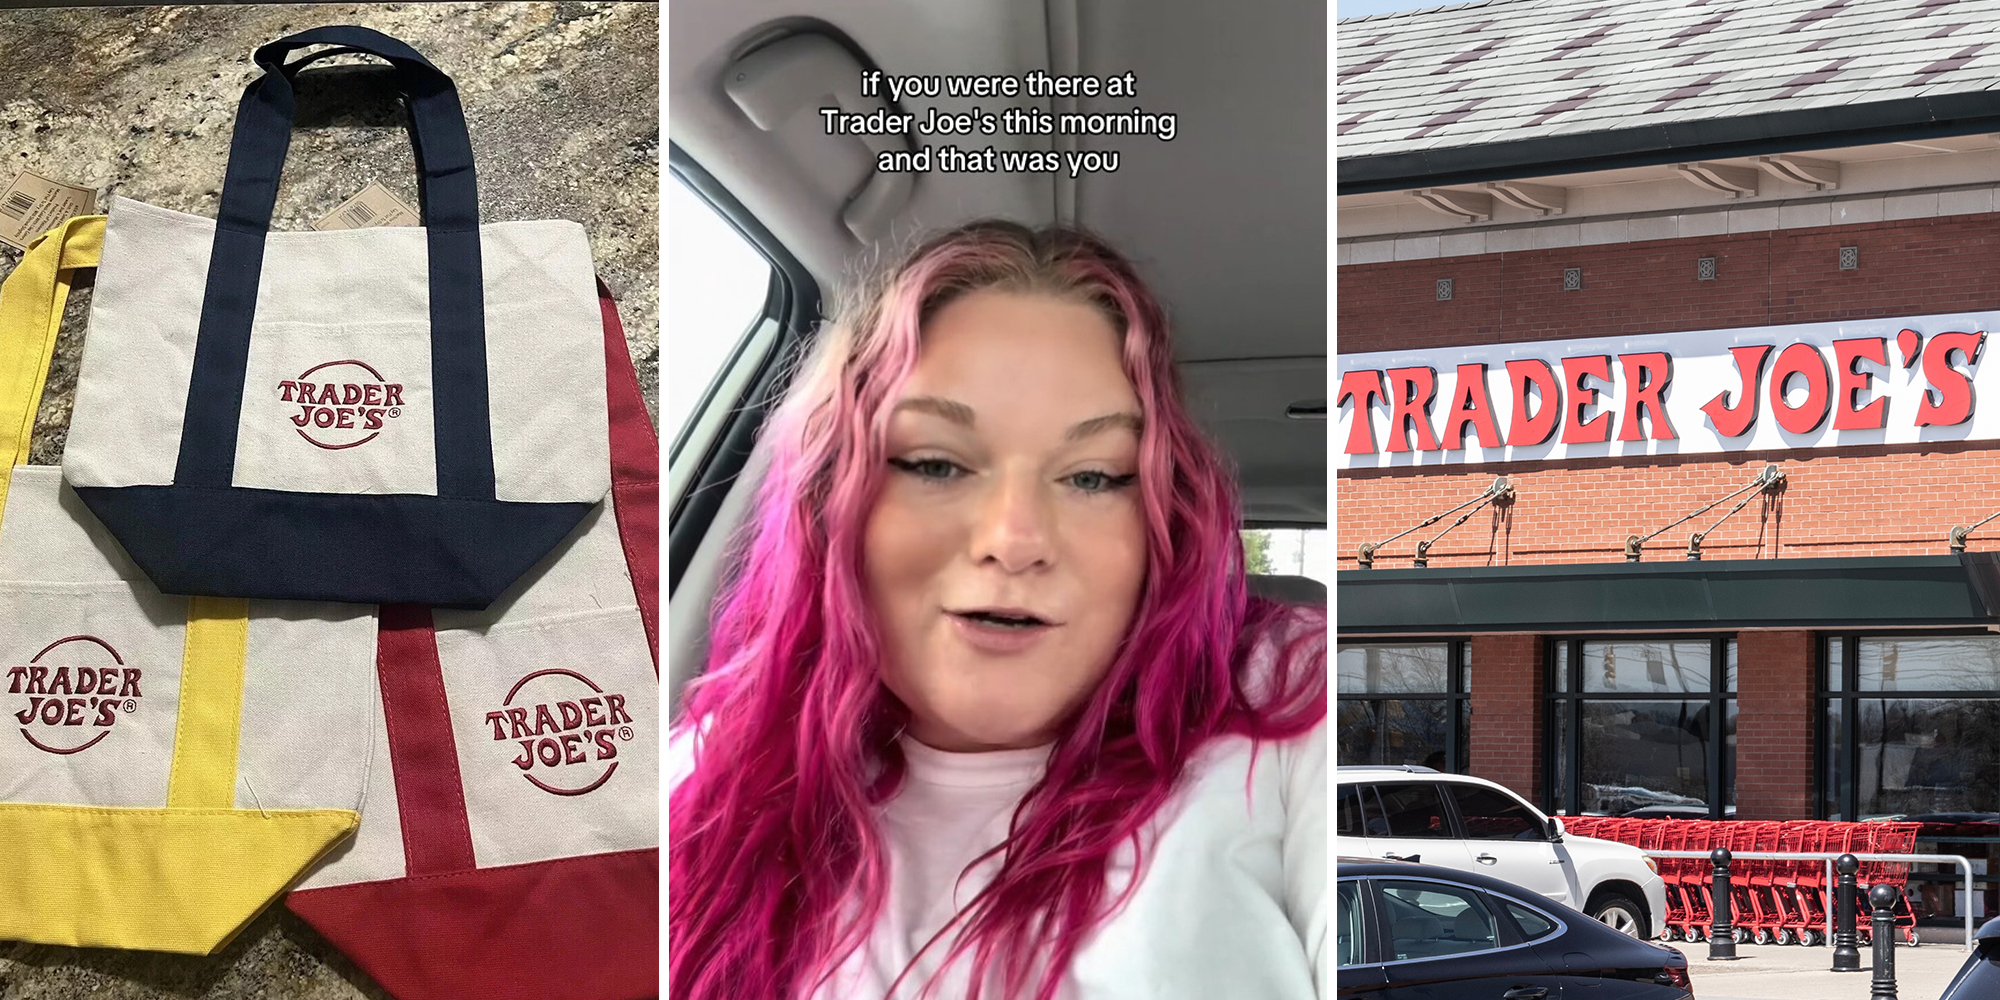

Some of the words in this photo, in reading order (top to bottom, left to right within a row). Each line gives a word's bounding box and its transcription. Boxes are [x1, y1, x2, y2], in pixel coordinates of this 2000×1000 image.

[277, 380, 405, 406] TRADER
[1337, 352, 1680, 455] TRADER
[1700, 329, 1987, 438] JOE'S
[290, 405, 387, 430] JOE'S
[6, 666, 143, 697] TRADER
[14, 696, 122, 727] JOE'S
[485, 694, 633, 741] TRADER
[511, 728, 617, 771] JOE'S
